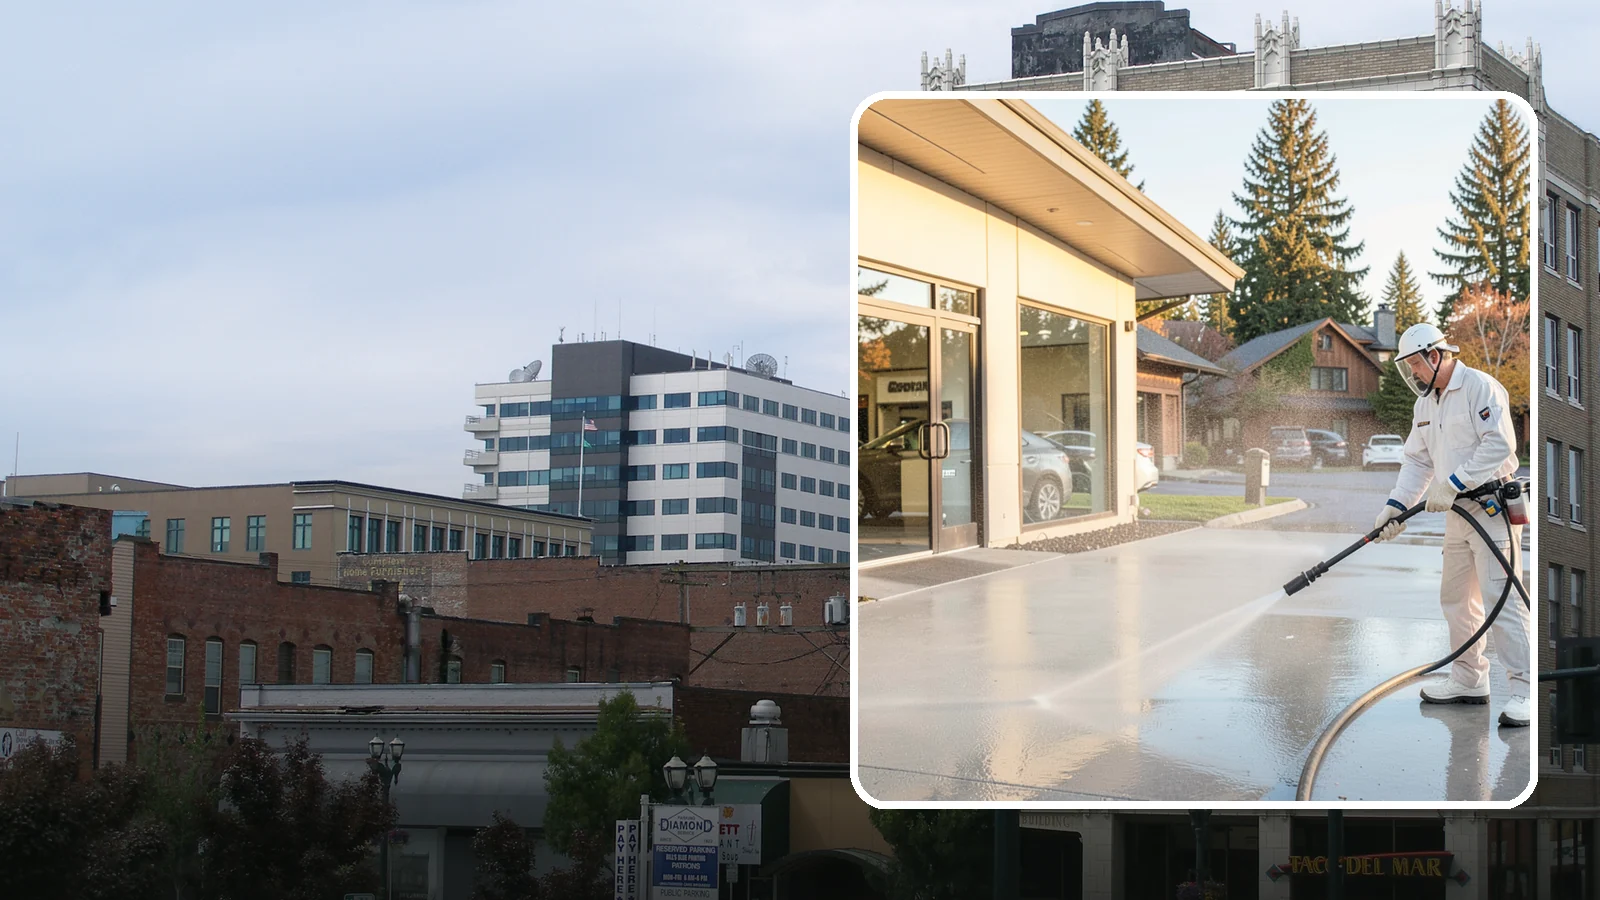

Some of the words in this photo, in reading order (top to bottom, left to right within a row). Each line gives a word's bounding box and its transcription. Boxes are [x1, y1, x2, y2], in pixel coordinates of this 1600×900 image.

[371, 566, 429, 577] Furnishers
[660, 818, 713, 833] DIAMOND
[1022, 815, 1071, 828] BUILDING
[719, 823, 740, 835] ETT
[617, 825, 625, 852] PAY
[628, 825, 636, 852] PAY
[719, 839, 740, 848] ANT
[656, 845, 688, 853] RESERVED
[689, 846, 716, 854] PARKING
[722, 851, 739, 861] Soup
[671, 862, 701, 870] PATRONS
[1346, 856, 1385, 876] DEL
[1392, 857, 1442, 877] MAR
[617, 856, 625, 893] HERE
[628, 856, 636, 893] HERE
[660, 888, 682, 897] PUBLIC
[683, 889, 710, 898] PARKING
